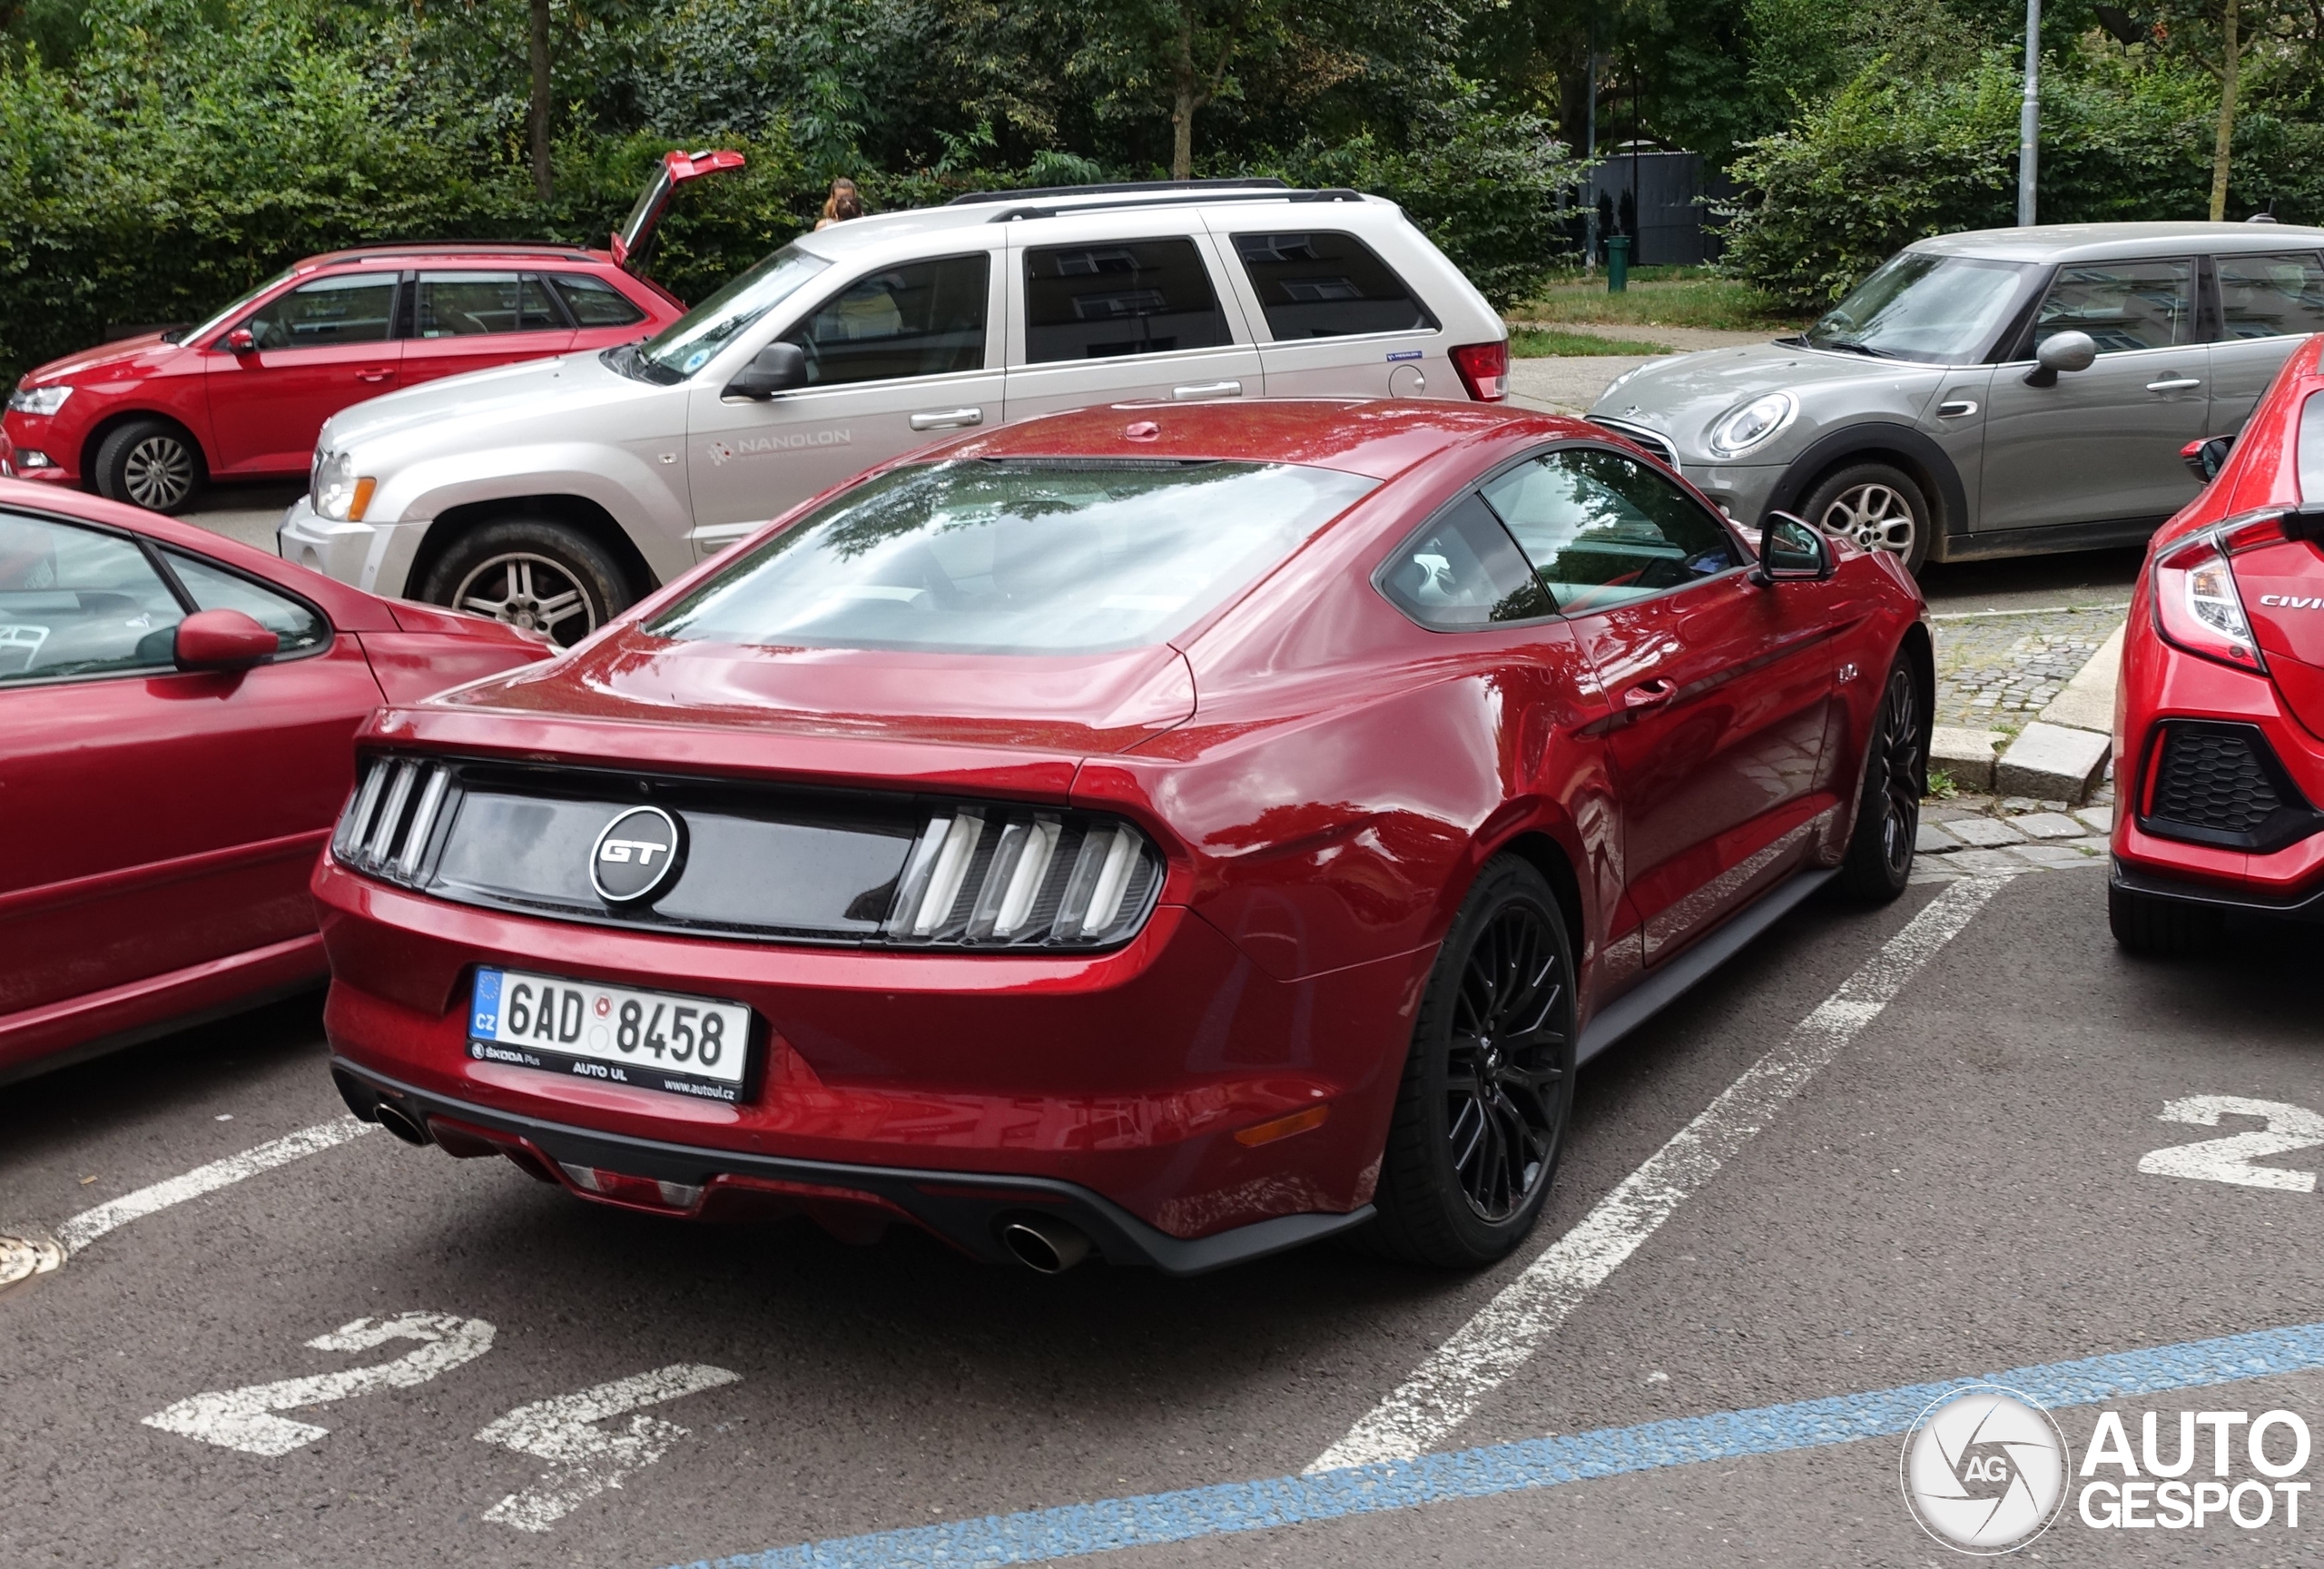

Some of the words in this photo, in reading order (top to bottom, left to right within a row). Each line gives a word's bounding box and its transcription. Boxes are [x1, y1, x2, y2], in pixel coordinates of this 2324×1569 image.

[738, 428, 852, 453] NANOLON
[2260, 594, 2324, 609] CIVI
[599, 839, 668, 865] GT
[475, 1012, 495, 1031] CZ
[508, 982, 585, 1043] 6AD
[616, 1000, 724, 1067] 8458
[485, 1046, 524, 1063] ŠKODA
[573, 1061, 608, 1080] AUTO
[611, 1068, 628, 1082] UL
[664, 1079, 735, 1100] www.autoul.cz
